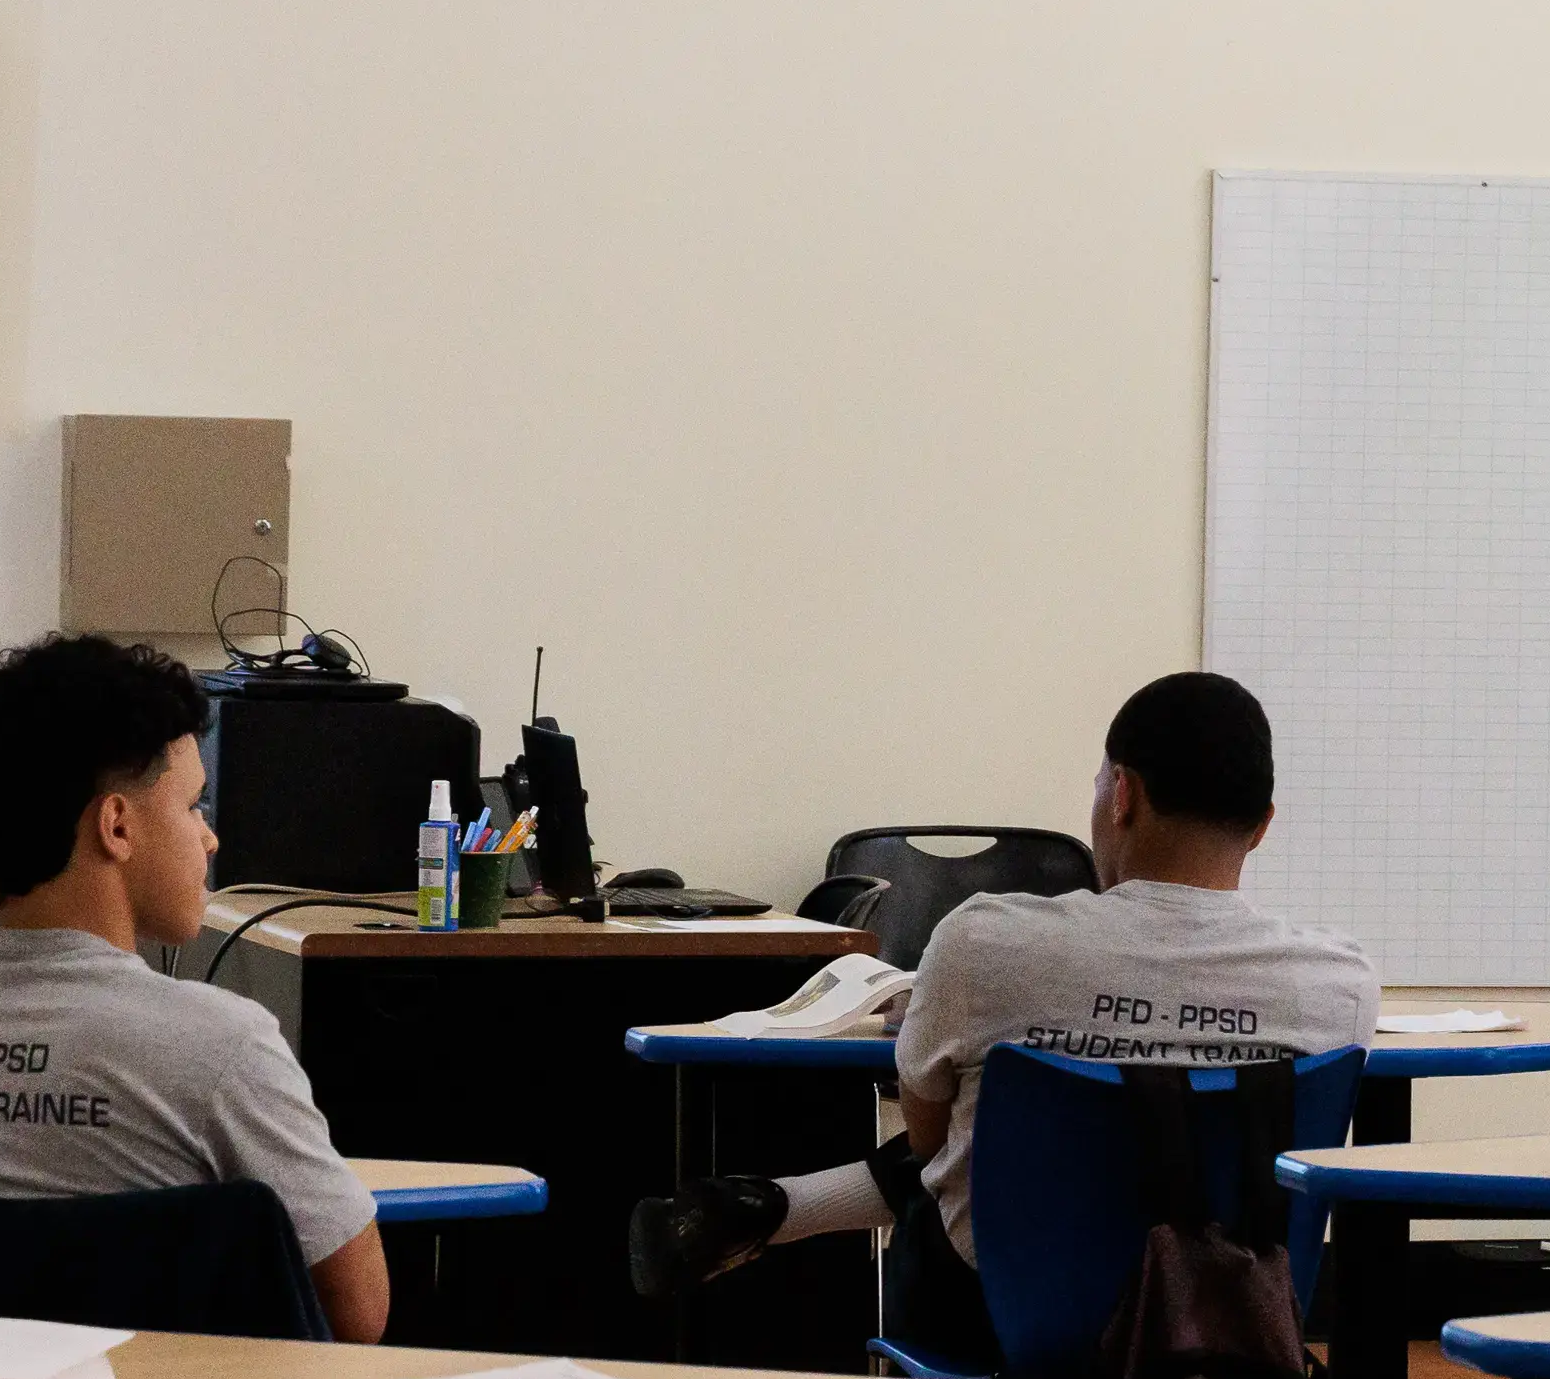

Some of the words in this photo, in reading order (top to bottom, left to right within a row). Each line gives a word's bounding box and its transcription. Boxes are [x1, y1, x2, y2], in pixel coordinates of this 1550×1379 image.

[1092, 994, 1152, 1024] PFD
[1178, 1004, 1258, 1036] PPSD
[1023, 1026, 1175, 1060] STUDENT
